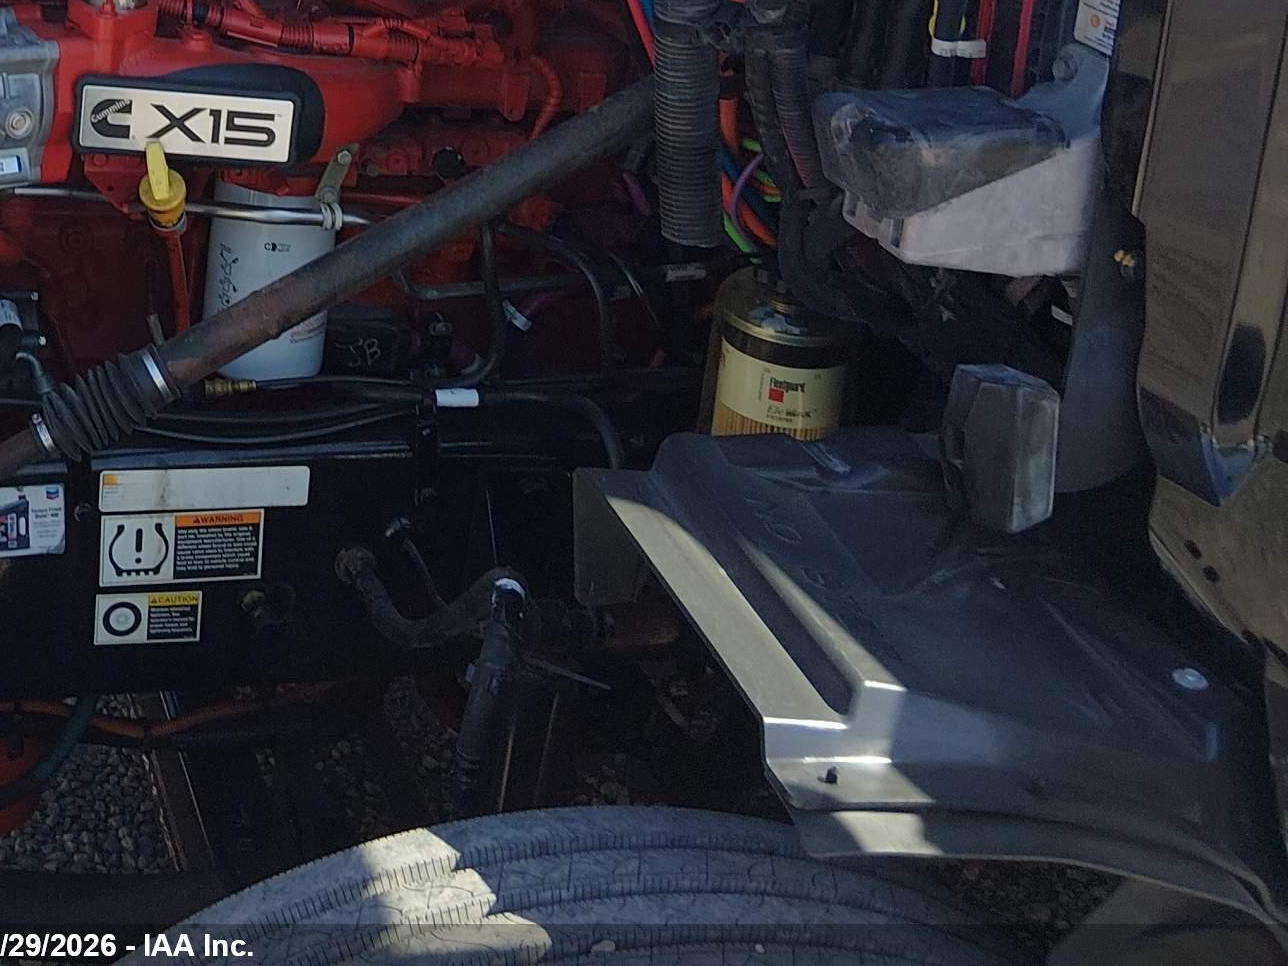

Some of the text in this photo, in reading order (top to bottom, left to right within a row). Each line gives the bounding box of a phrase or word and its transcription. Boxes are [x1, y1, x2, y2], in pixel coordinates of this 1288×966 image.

[90, 99, 131, 124] Cummins
[145, 103, 276, 148] X15
[200, 514, 244, 524] WARNING
[159, 595, 199, 604] CAUTION
